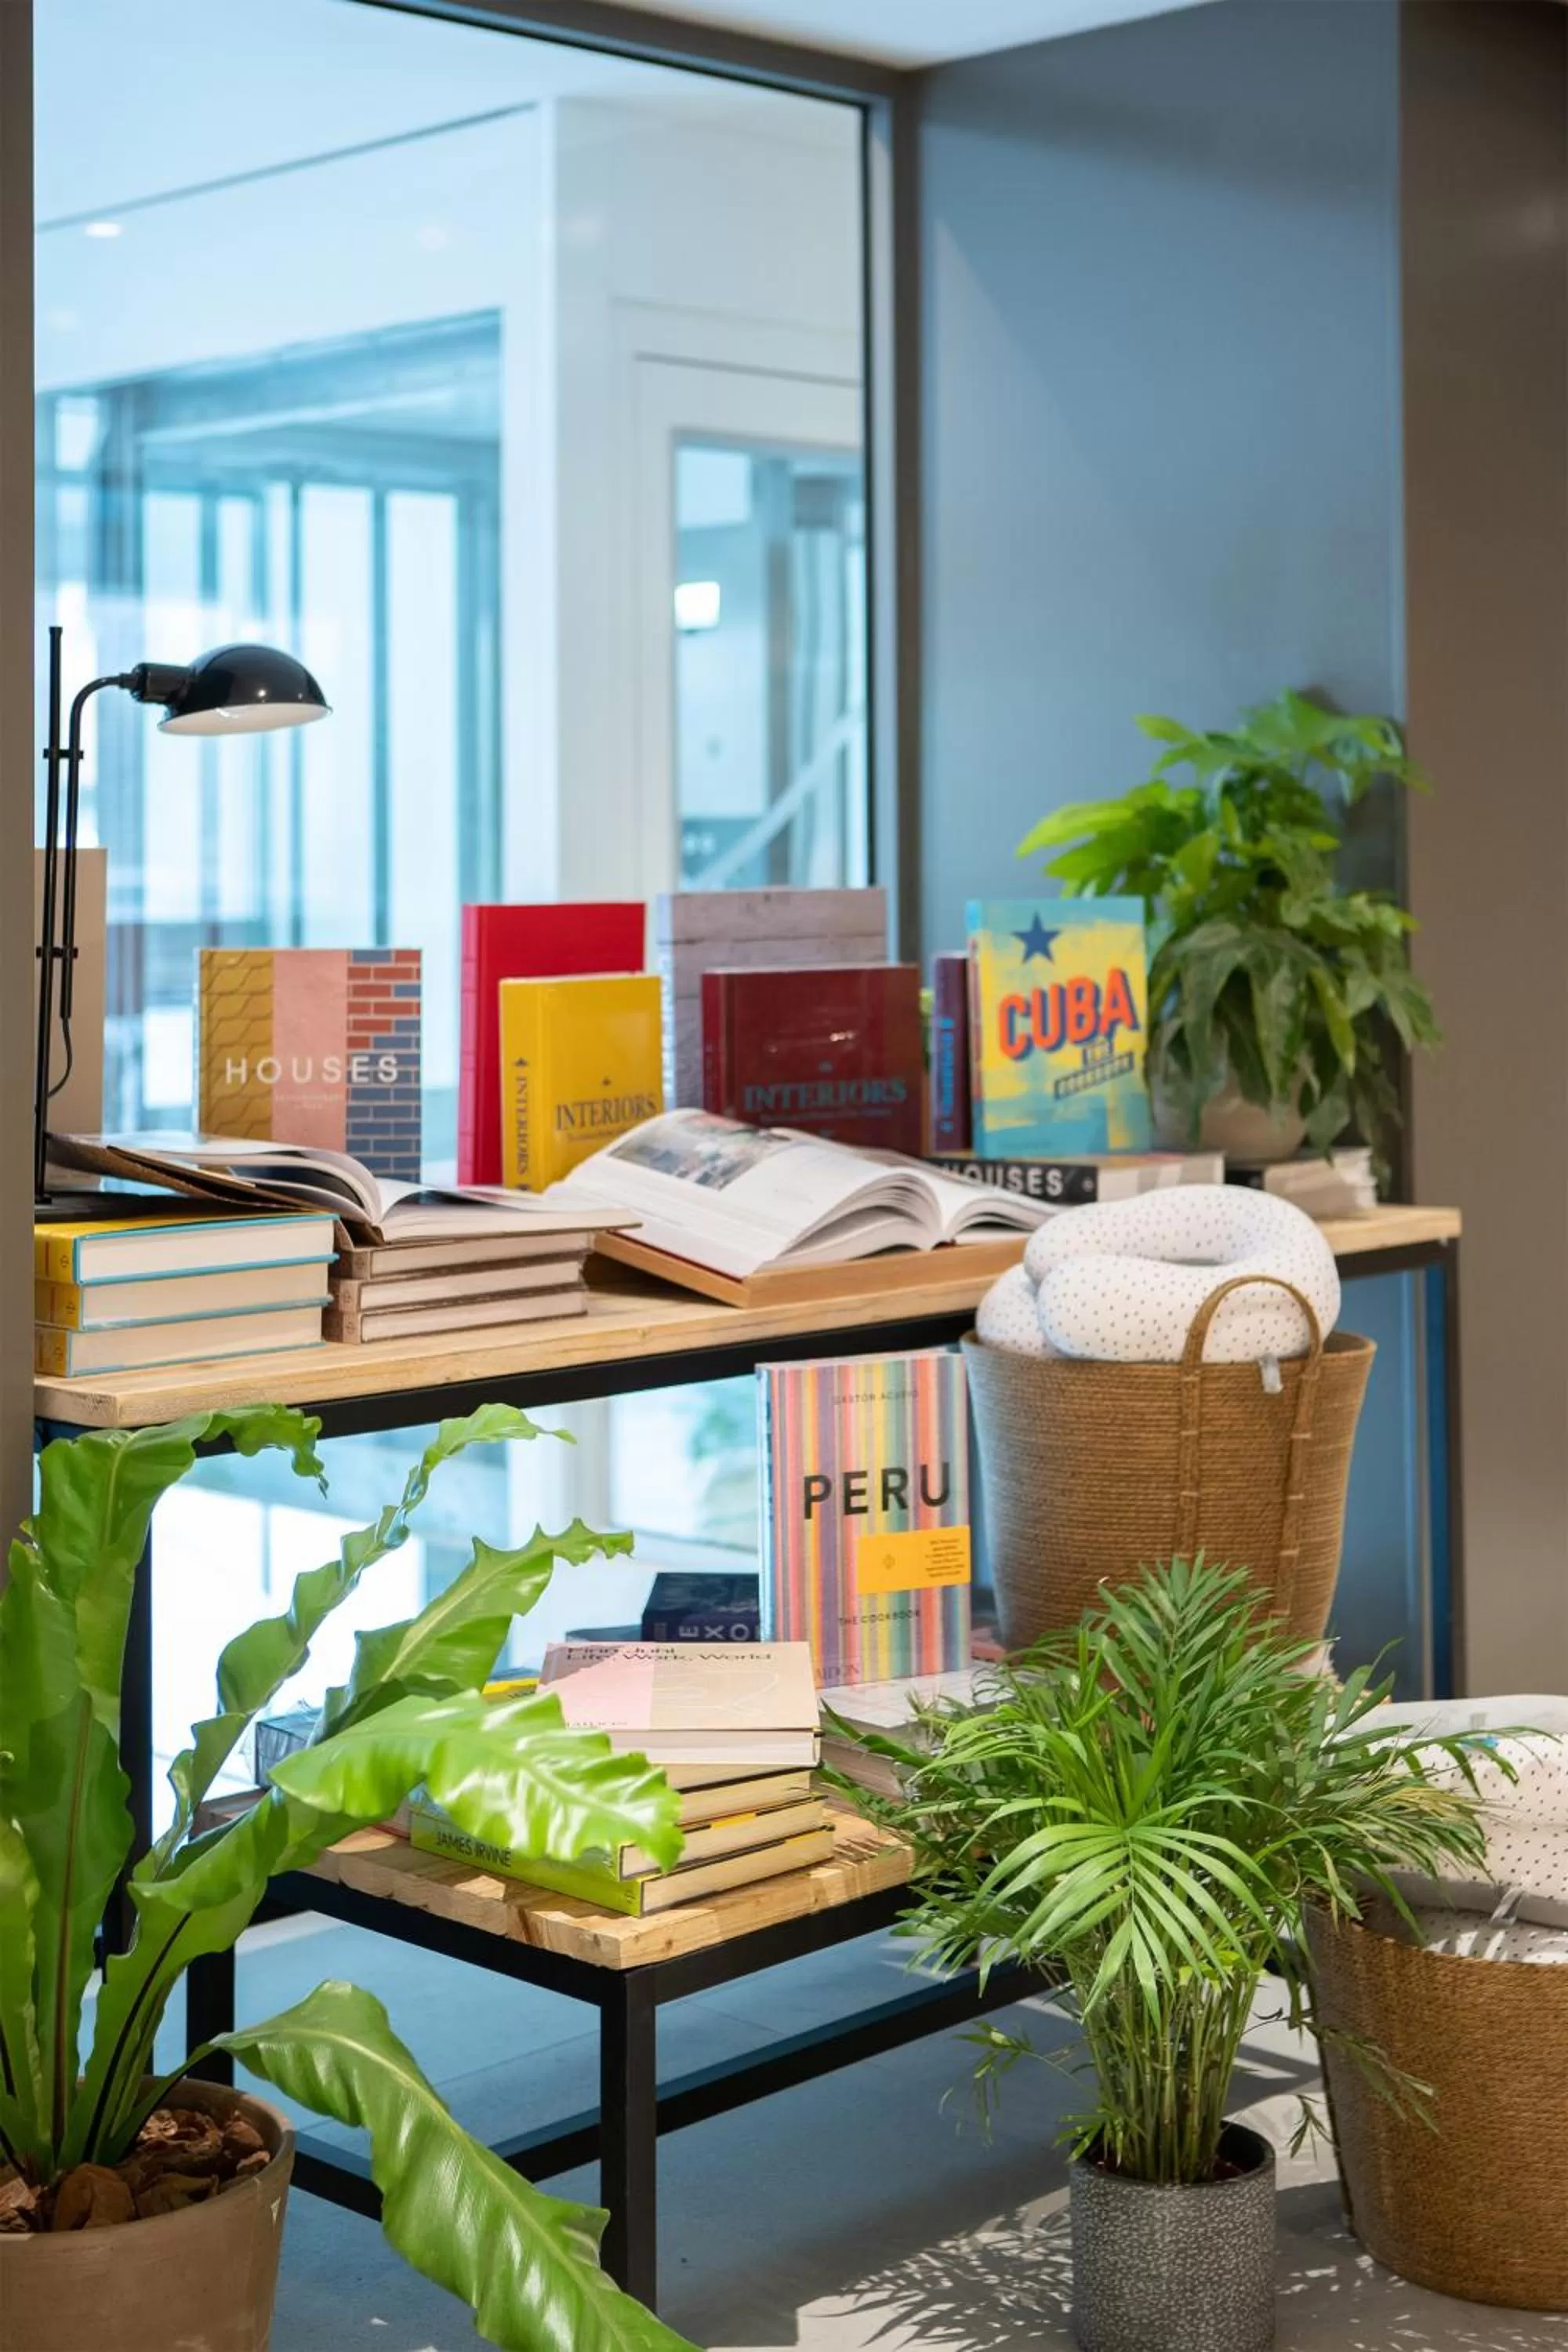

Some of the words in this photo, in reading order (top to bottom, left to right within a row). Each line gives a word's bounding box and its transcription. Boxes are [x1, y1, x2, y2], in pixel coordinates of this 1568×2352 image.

[999, 967, 1139, 1062] CUBA
[225, 1055, 399, 1085] HOUSES
[556, 1093, 658, 1130] INTERIORS
[744, 1079, 907, 1111] INTERIORS
[804, 1461, 950, 1519] PERU
[678, 1623, 760, 1641] EXO
[436, 1831, 473, 1856] JAMES
[475, 1842, 512, 1867] IRVINE
